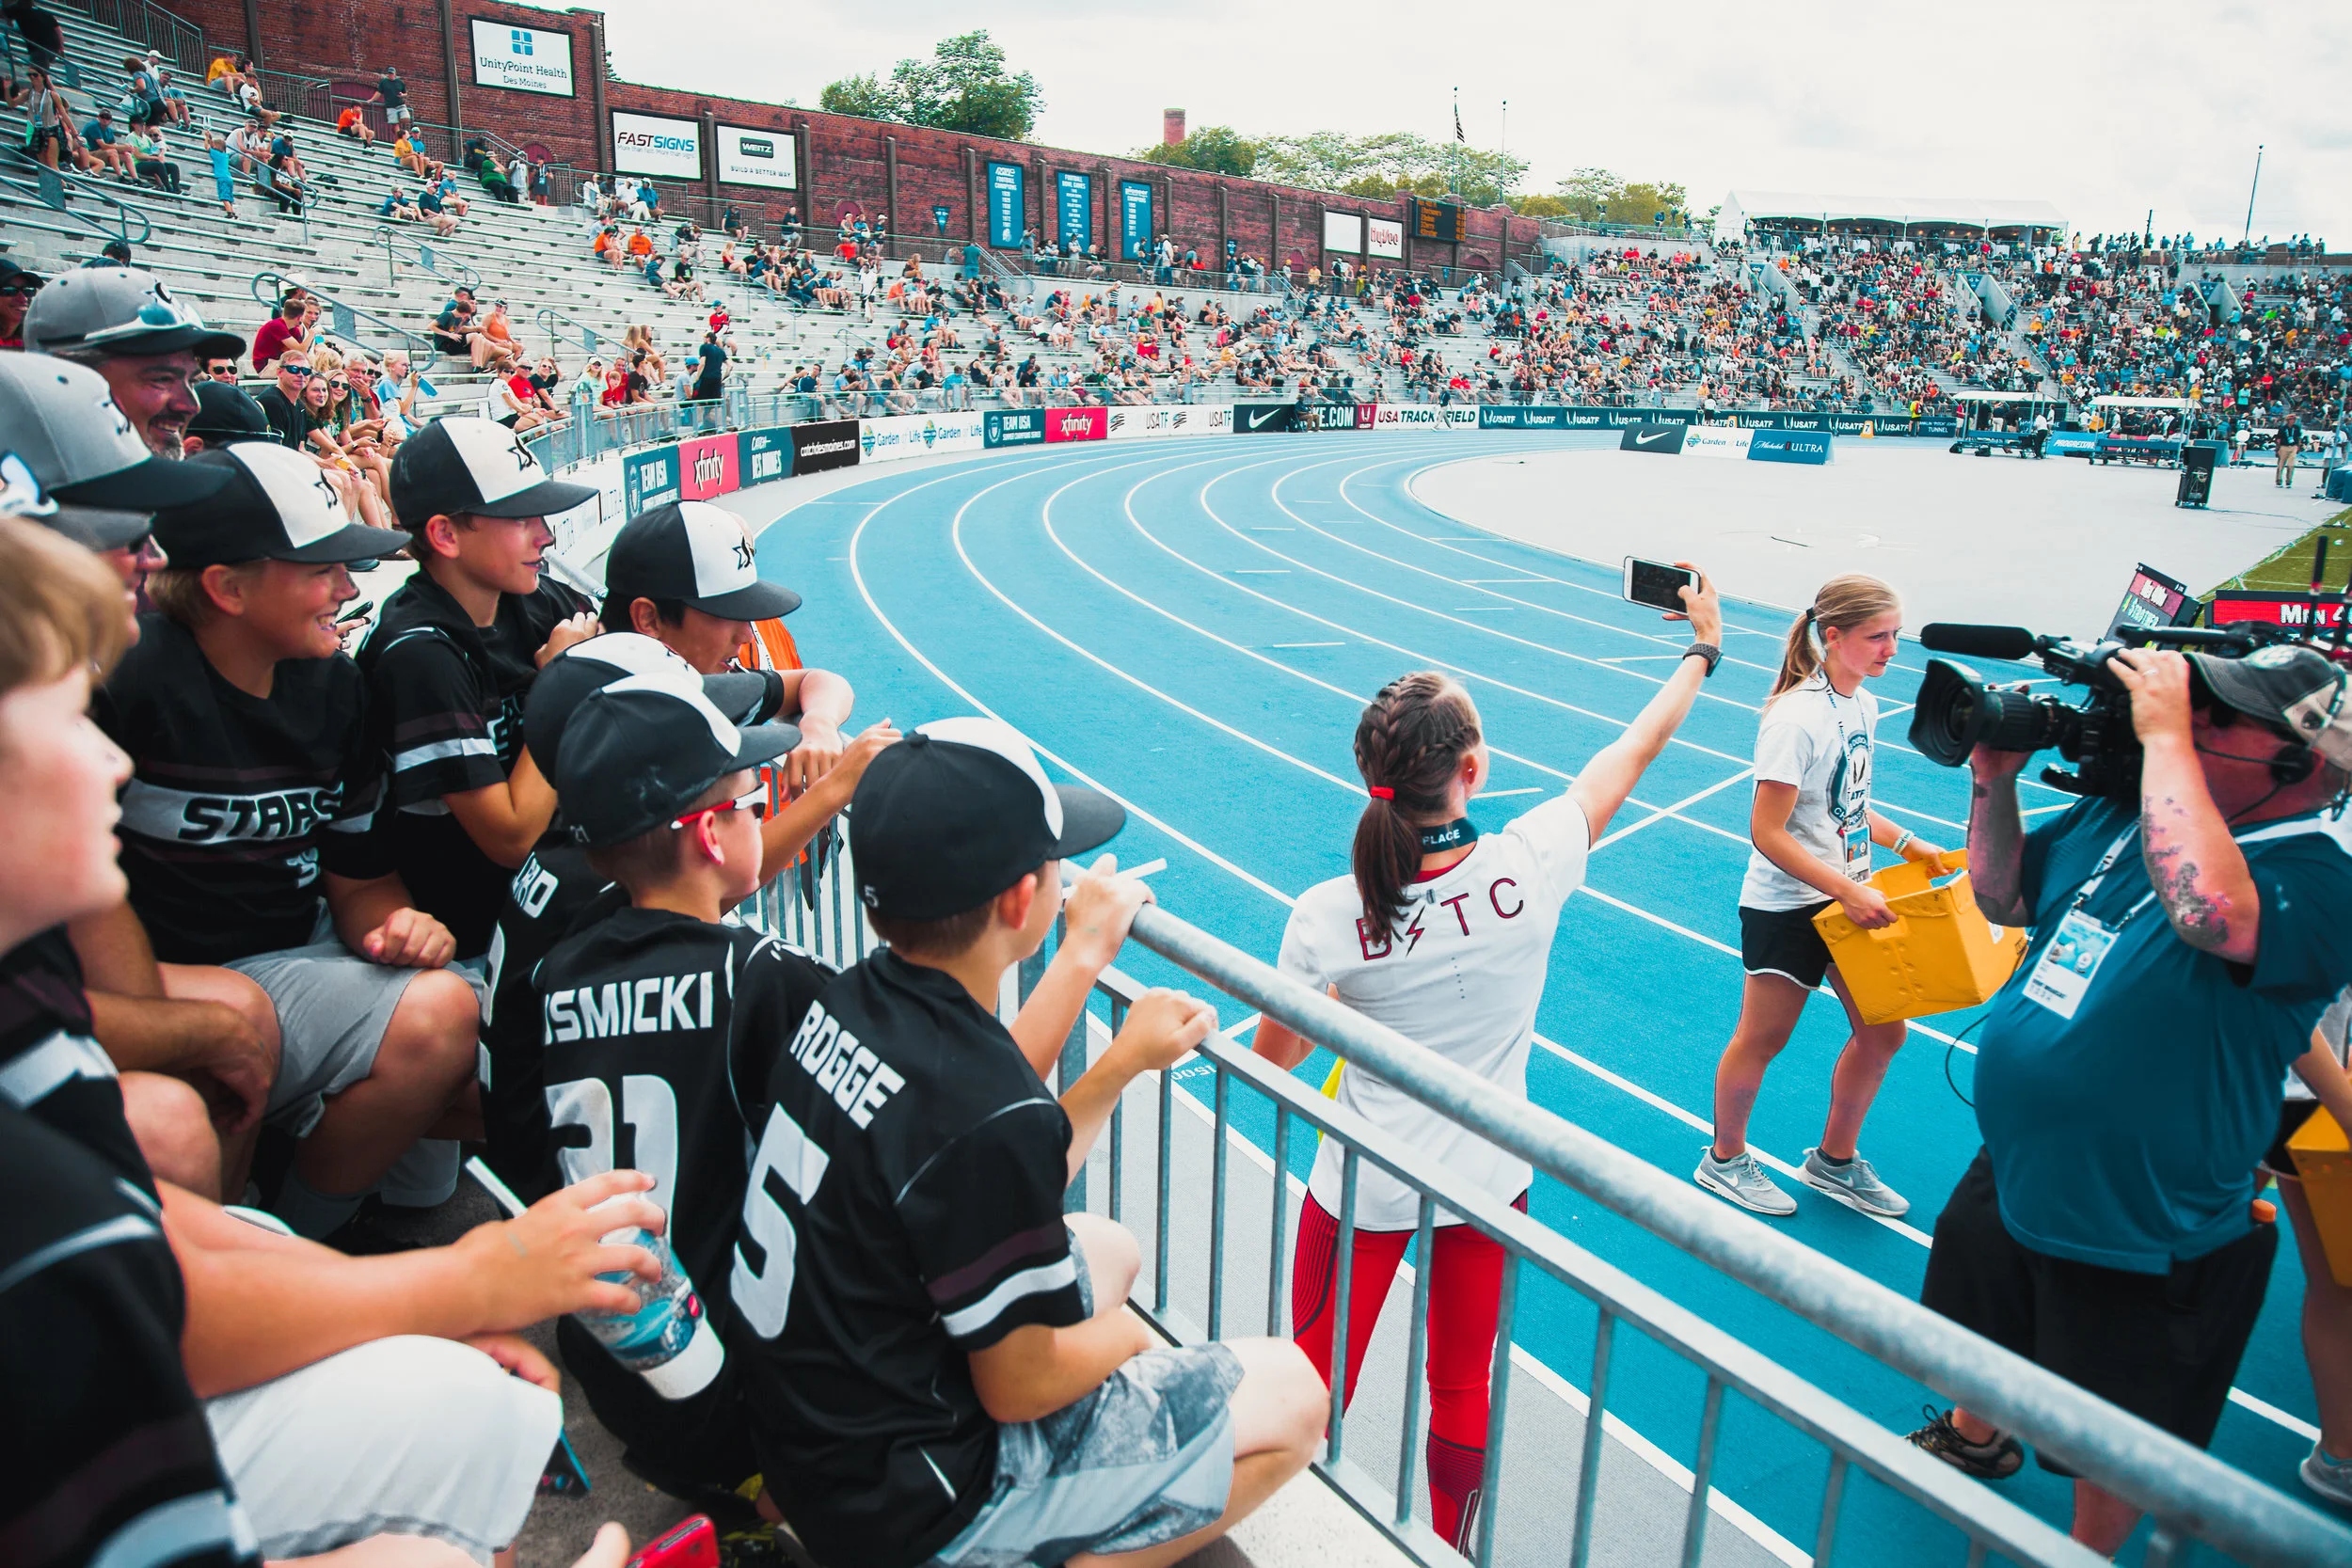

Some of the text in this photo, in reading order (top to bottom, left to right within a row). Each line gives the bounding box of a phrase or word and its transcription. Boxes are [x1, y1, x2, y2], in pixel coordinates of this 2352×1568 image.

[480, 56, 567, 79] UnityPoint Health
[502, 75, 548, 89] Des Moines
[617, 132, 695, 152] FASTSIGNS
[741, 142, 772, 153] WEITZ
[755, 167, 776, 177] BETTER
[1003, 415, 1031, 430] TEAM USA
[1146, 411, 1168, 430] USATF
[1209, 410, 1232, 427] USATF
[1378, 410, 1398, 423] USA
[1400, 410, 1435, 423] TRACK
[1446, 410, 1476, 423] FIELD
[1492, 415, 1517, 424] USATF
[1534, 416, 1555, 424] USATF
[1576, 416, 1599, 425] USATF
[1661, 417, 1686, 426] USATF
[1061, 414, 1092, 437] xfinity
[1728, 420, 1734, 428] 8
[1749, 420, 1773, 428] USATF
[1793, 420, 1819, 429] USATF
[1839, 422, 1864, 431] USATF
[1864, 424, 1870, 433] 7
[1884, 423, 1909, 432] USATF
[877, 433, 900, 447] Garden
[909, 430, 921, 443] Life
[938, 427, 961, 440] Garden
[970, 425, 982, 437] Life
[800, 439, 856, 457] catchdesmoines.com
[1702, 437, 1749, 448] Garden Life
[1791, 442, 1824, 453] ULTRA
[693, 448, 724, 492] xfinity
[640, 462, 656, 494] TEAM
[864, 884, 879, 909] 5
[789, 999, 906, 1131] ROGGE
[729, 1101, 830, 1340] 5
